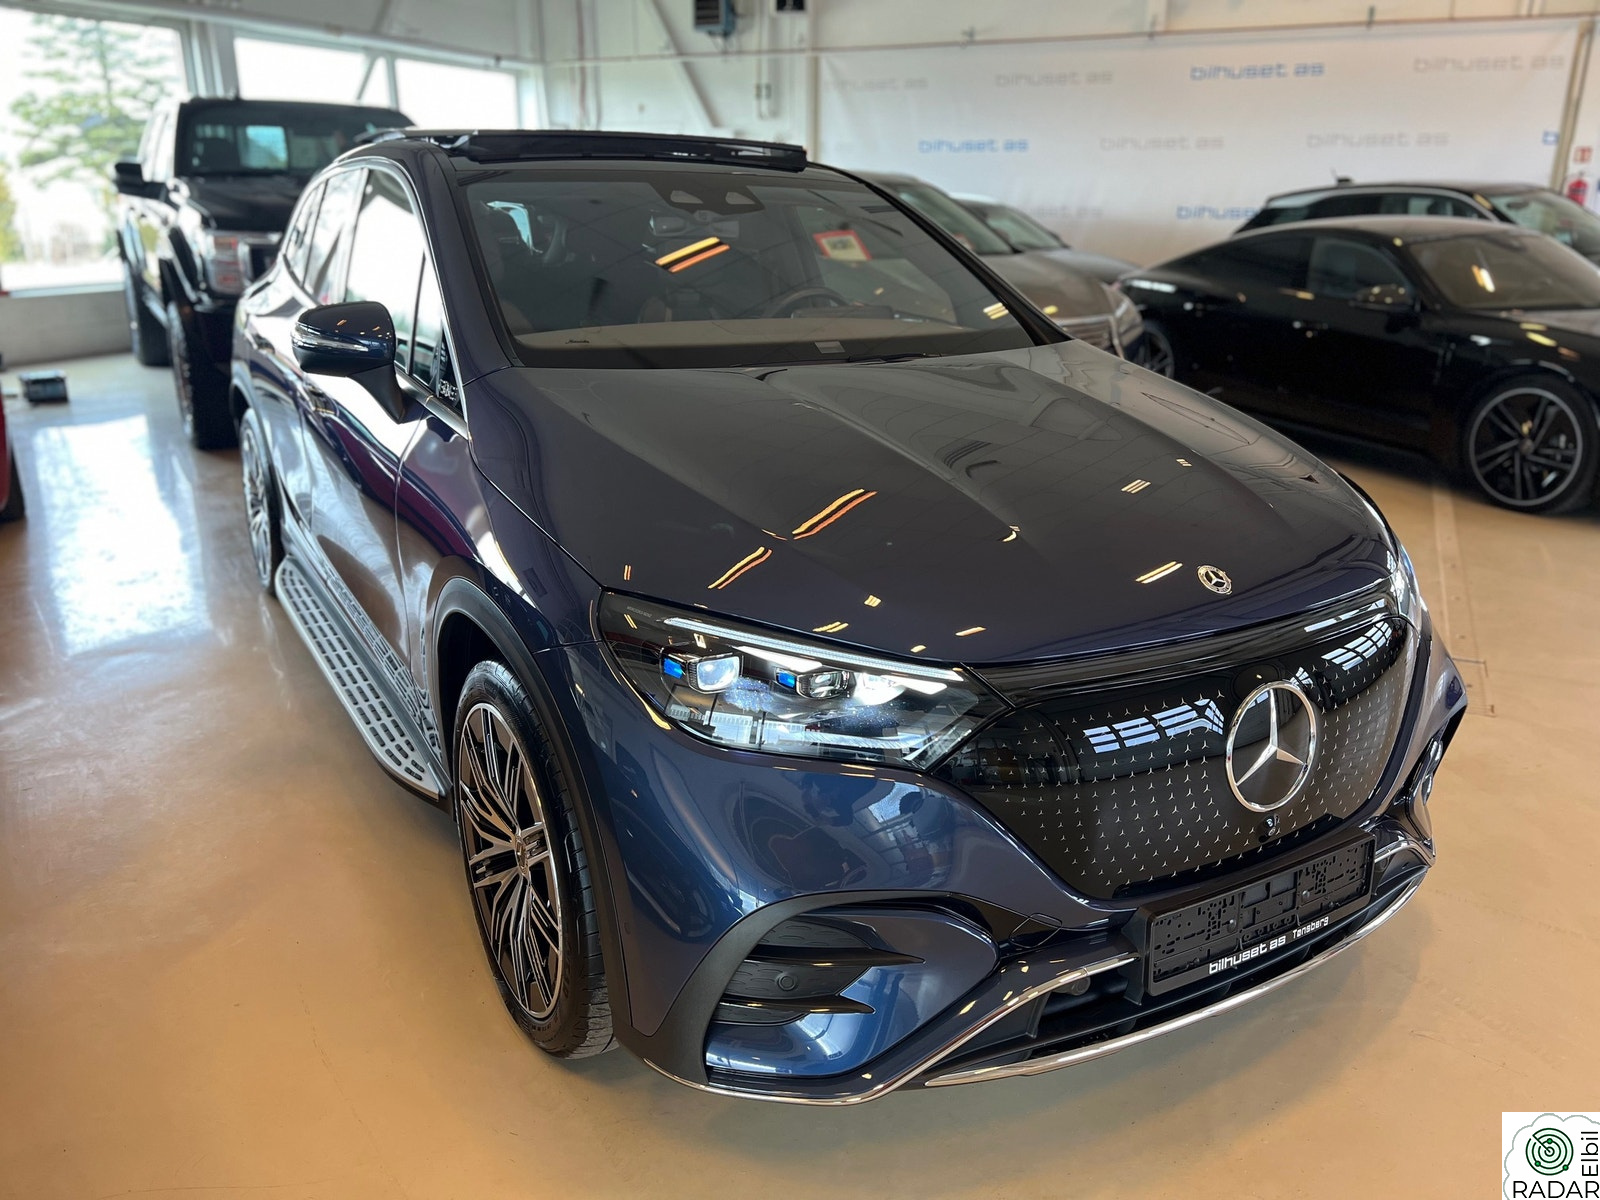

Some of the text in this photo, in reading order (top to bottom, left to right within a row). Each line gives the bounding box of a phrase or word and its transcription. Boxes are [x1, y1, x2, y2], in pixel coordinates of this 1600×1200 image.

[1190, 61, 1325, 81] bilhuset as
[1176, 205, 1257, 221] bilhuse
[1208, 942, 1268, 975] bilhuset
[1269, 935, 1287, 950] as
